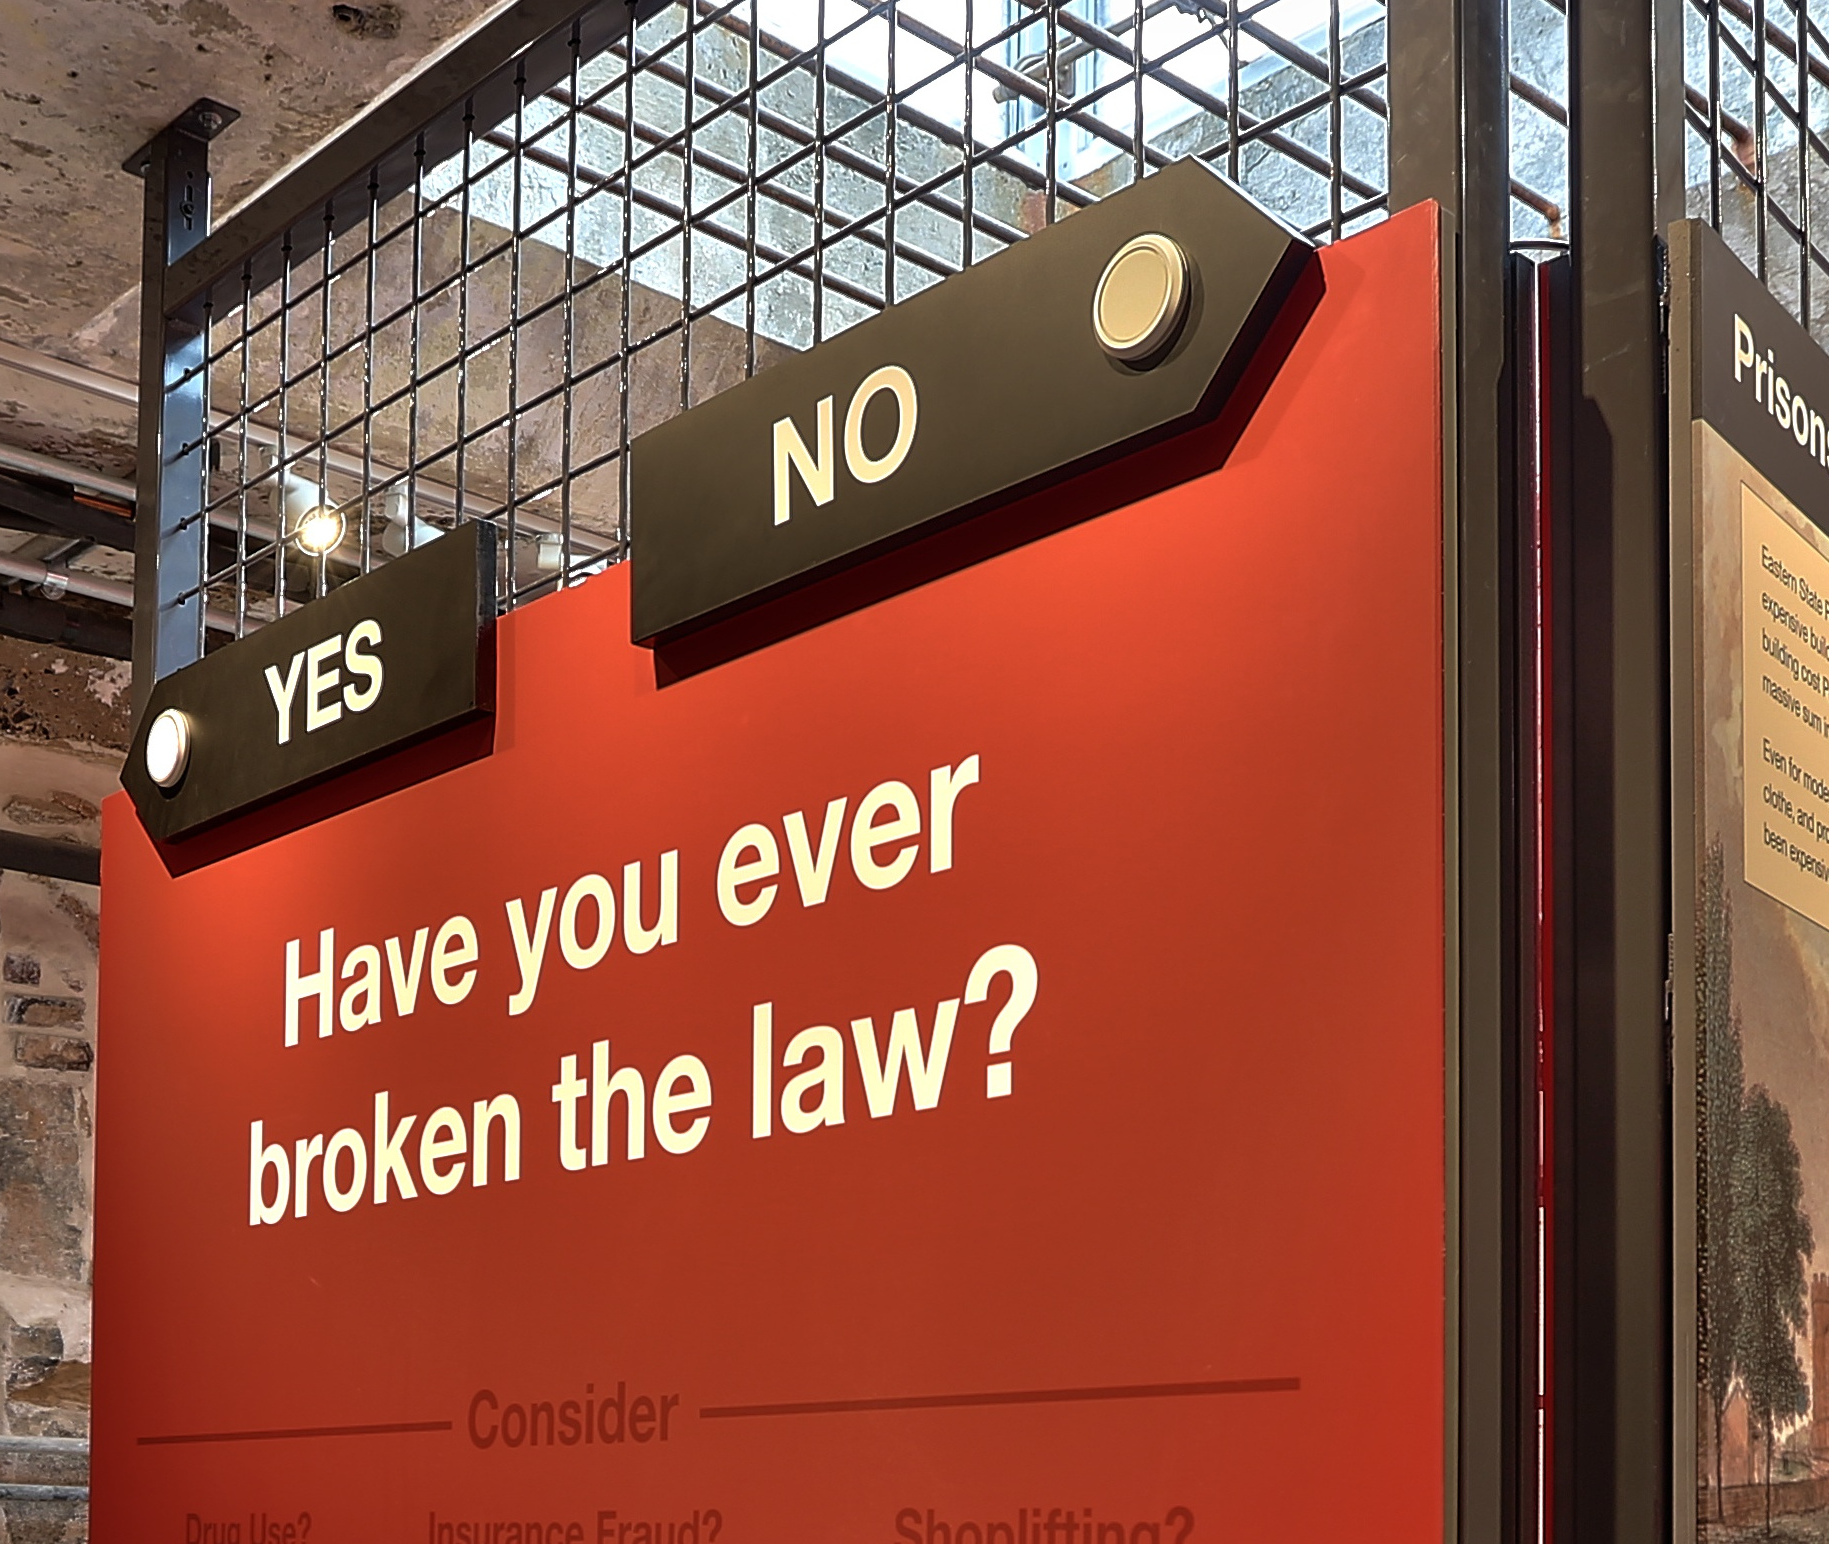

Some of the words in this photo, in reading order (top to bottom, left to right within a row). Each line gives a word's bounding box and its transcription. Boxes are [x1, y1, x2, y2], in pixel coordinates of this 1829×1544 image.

[771, 364, 919, 528] NO
[1762, 544, 1797, 594] Eastern
[1799, 577, 1824, 616] State
[1762, 592, 1808, 643] expensive
[264, 619, 385, 745] YES
[1762, 627, 1799, 681] building
[1801, 665, 1821, 694] cost
[1762, 675, 1801, 718] massive
[1802, 706, 1822, 734] sum
[1763, 737, 1786, 774] Even
[1788, 756, 1802, 783] for
[1763, 783, 1795, 824] clothe,
[1797, 808, 1815, 833] and
[1763, 821, 1788, 857] been
[282, 913, 479, 1049] Have
[505, 848, 681, 1015] you
[716, 754, 981, 927] ever
[248, 1090, 521, 1227] broken
[552, 1039, 712, 1176] the
[751, 943, 1040, 1140] law?
[467, 1381, 680, 1449] Consider
